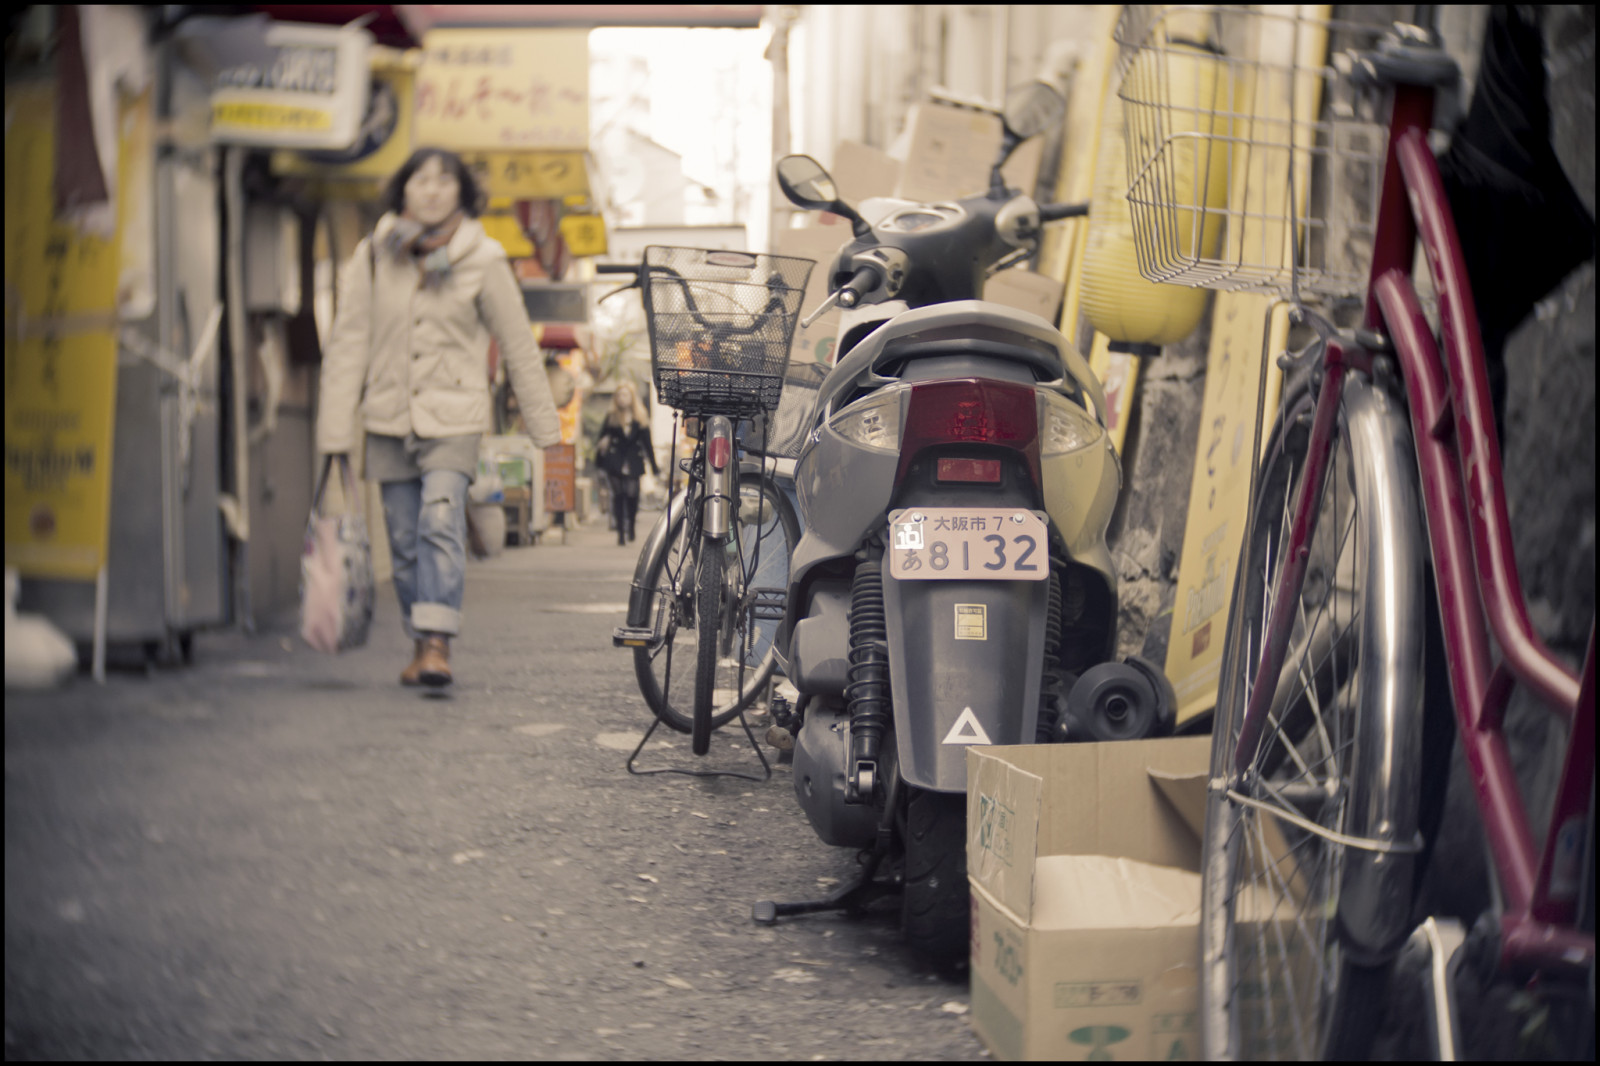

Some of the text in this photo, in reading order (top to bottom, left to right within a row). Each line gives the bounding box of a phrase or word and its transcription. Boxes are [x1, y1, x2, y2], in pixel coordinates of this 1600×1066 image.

[934, 516, 1003, 531] 大阪市 7
[902, 534, 1037, 571] あ 8132
